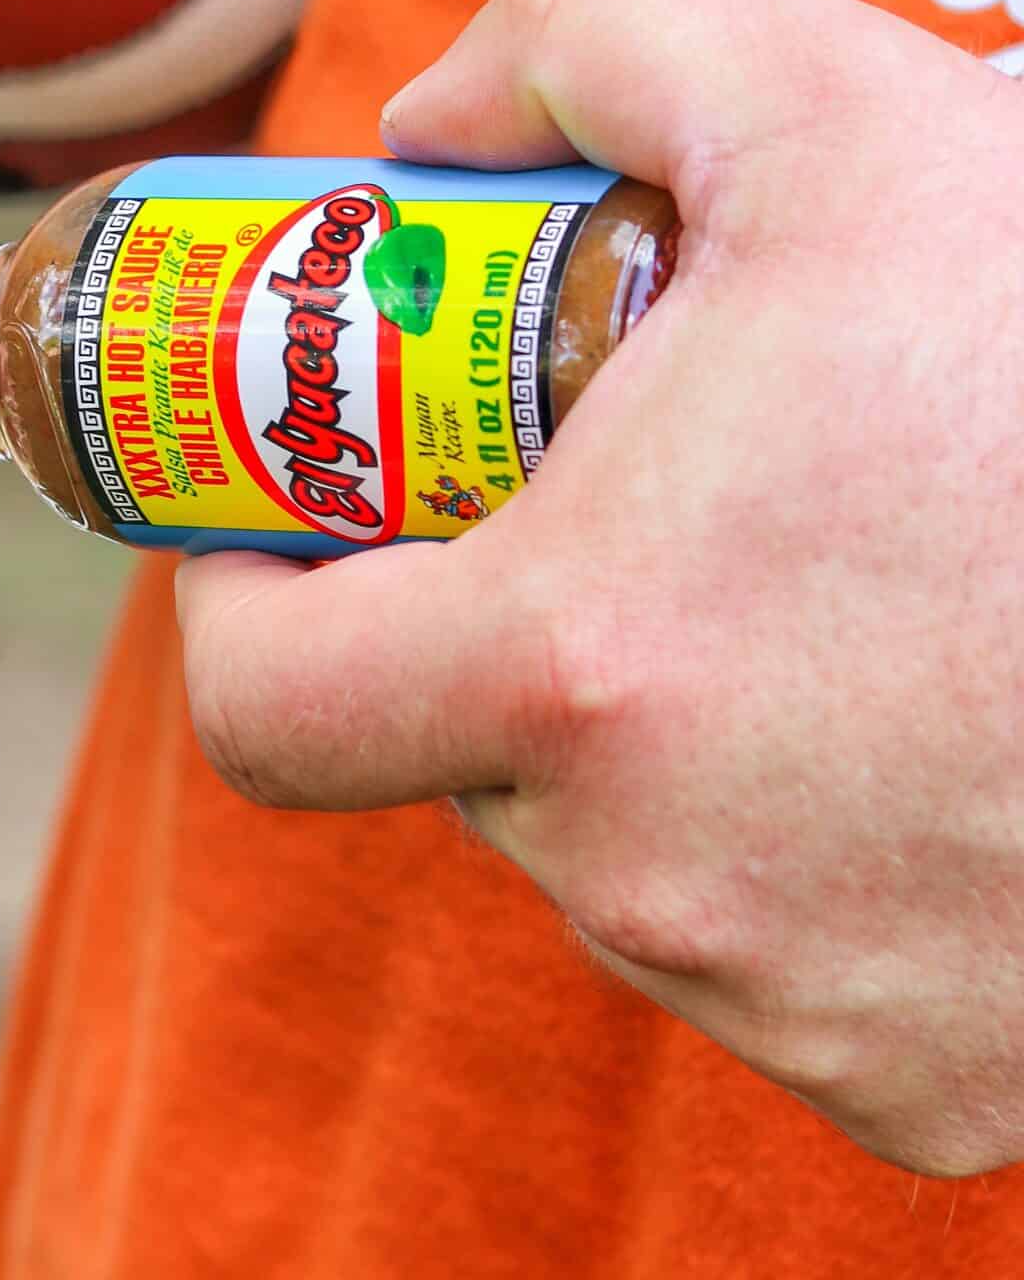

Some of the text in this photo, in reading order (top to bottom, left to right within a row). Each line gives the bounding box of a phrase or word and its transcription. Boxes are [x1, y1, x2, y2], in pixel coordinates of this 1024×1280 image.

[173, 228, 194, 250] de
[106, 224, 176, 500] XXXTRA HOT SAUCE
[151, 359, 178, 441] Picante
[169, 243, 231, 487] CHILE HABANERO
[260, 196, 384, 529] El Yucateco
[415, 392, 445, 470] Mayan
[469, 250, 520, 493] 4 fl oz (120 ml)
[163, 446, 199, 498] Salsa
